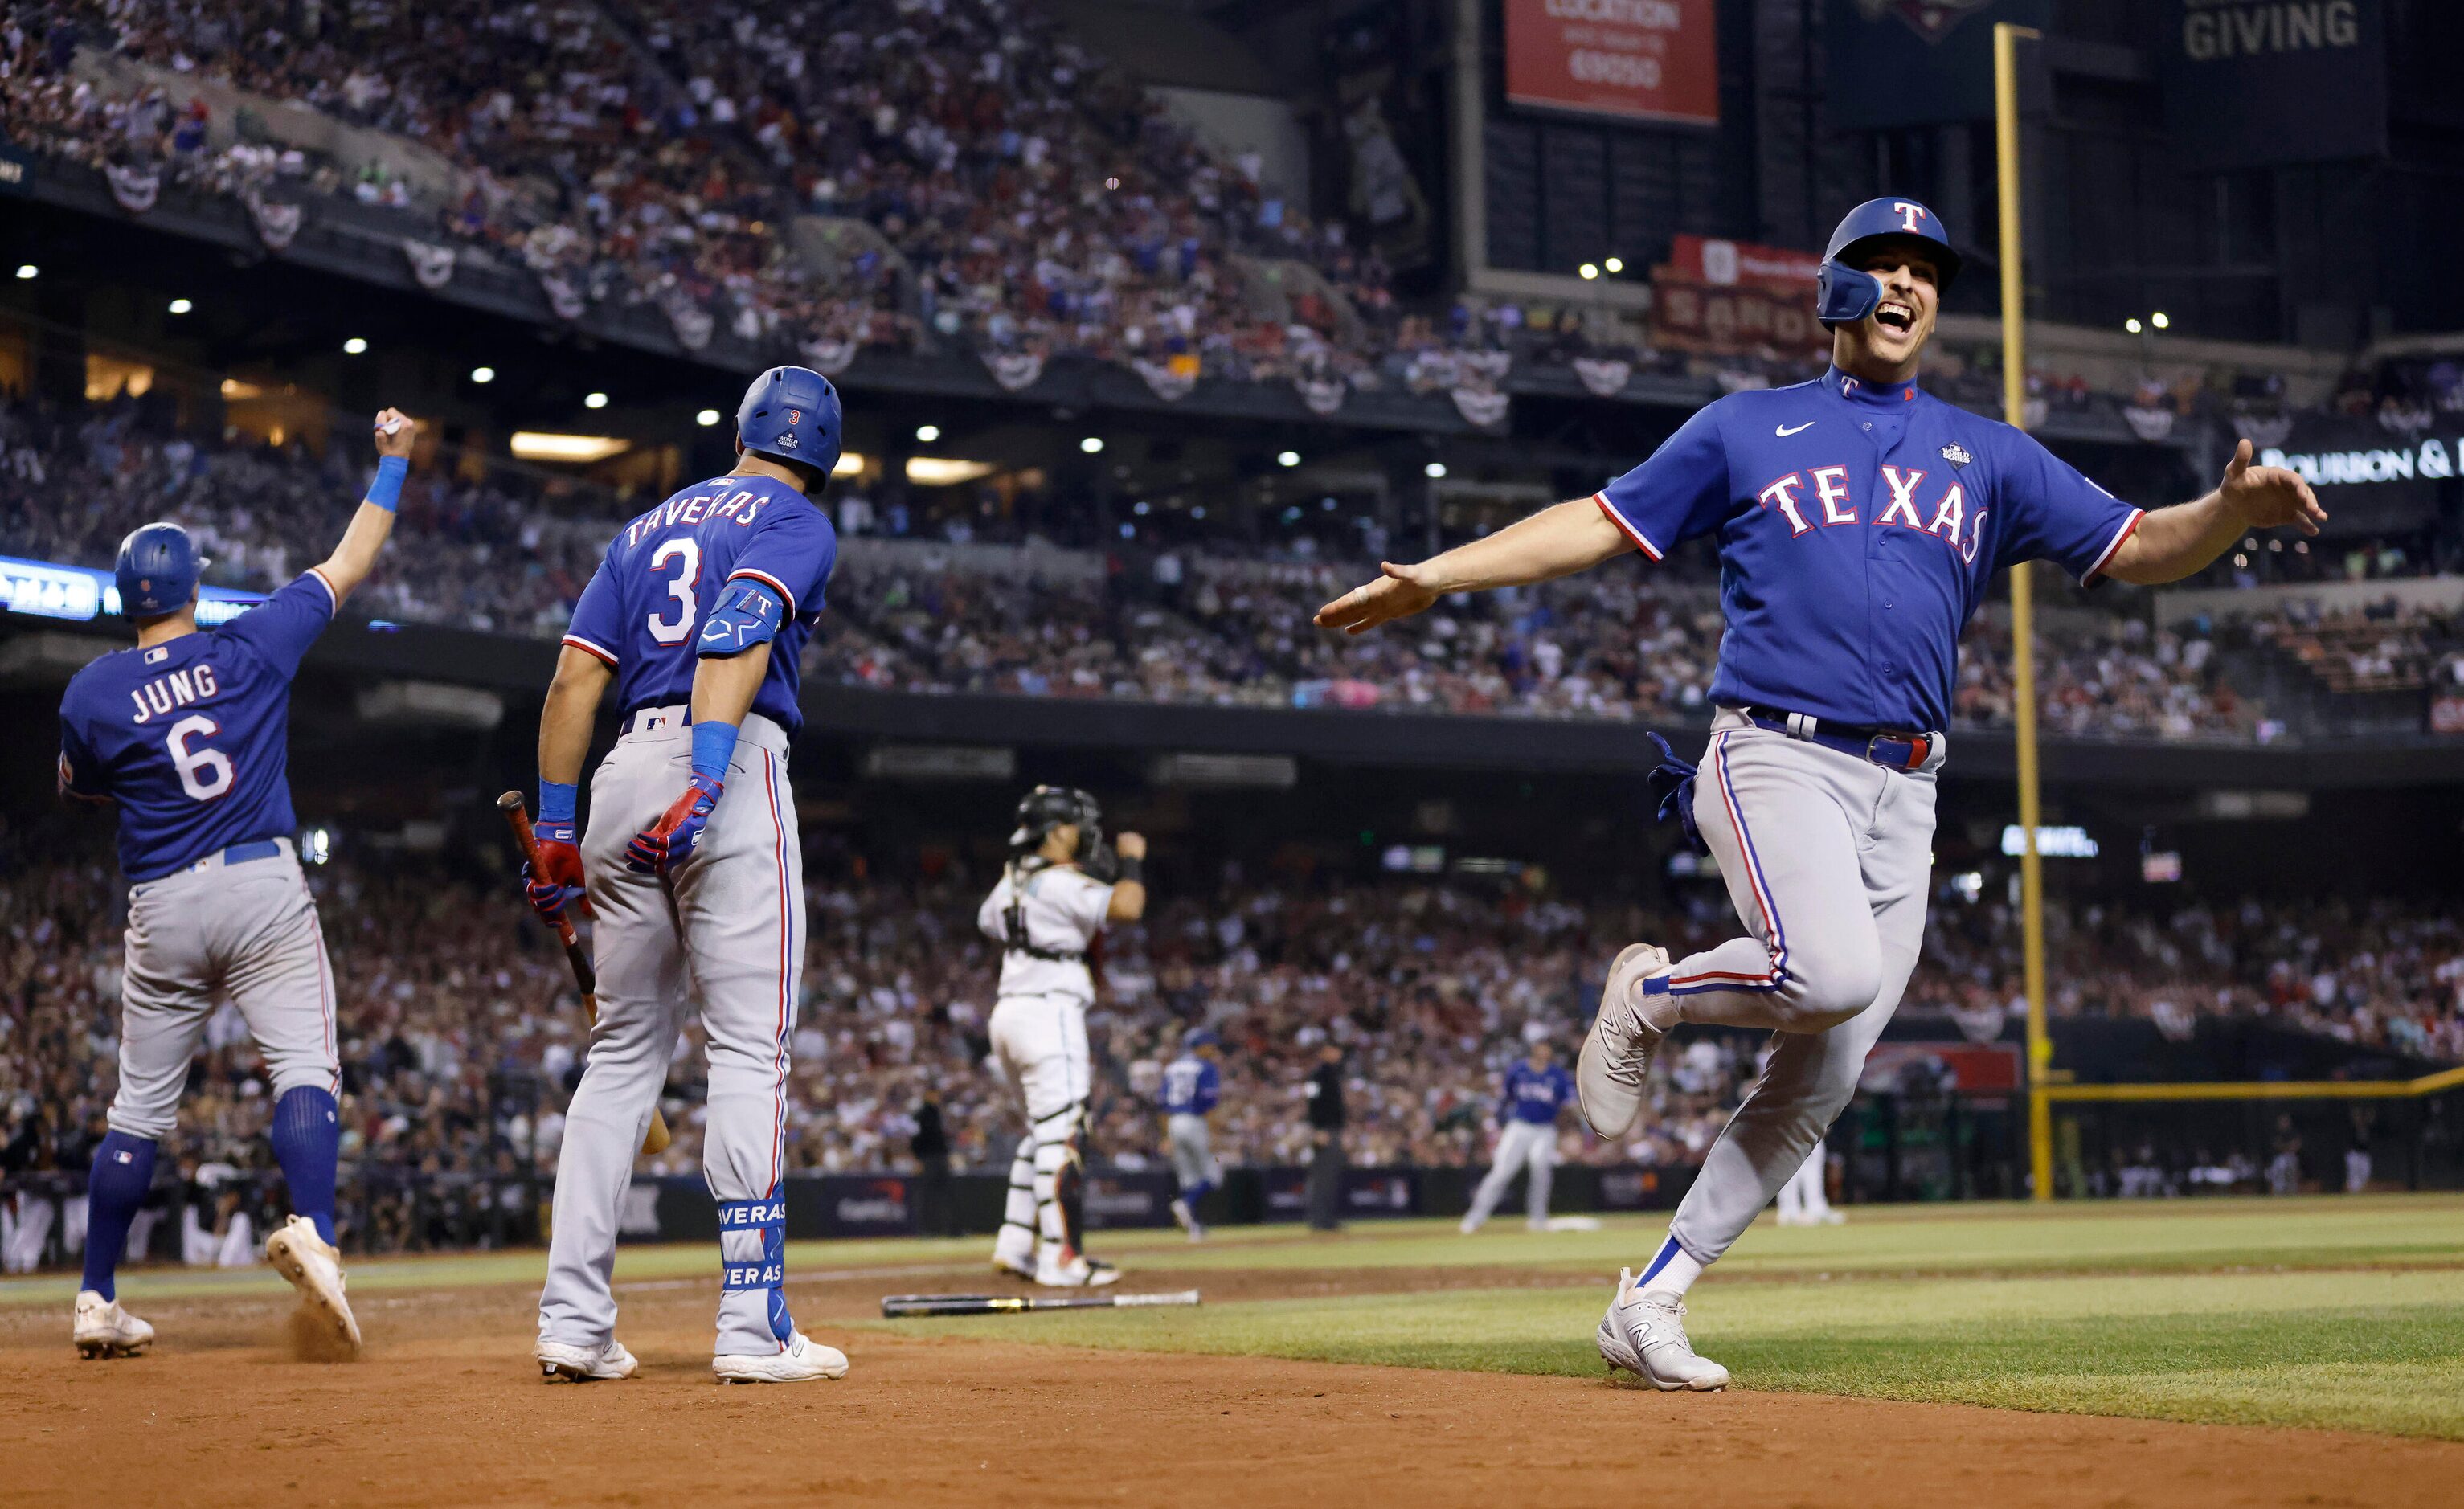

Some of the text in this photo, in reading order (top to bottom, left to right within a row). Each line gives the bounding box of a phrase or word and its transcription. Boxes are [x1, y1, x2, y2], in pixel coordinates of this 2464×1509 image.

[2184, 2, 2358, 60] GIVING
[1894, 202, 1926, 234] T
[1841, 375, 1860, 399] T
[788, 409, 800, 425] 3
[777, 440, 797, 449] SERIES
[779, 435, 798, 445] WORLD
[1942, 448, 1970, 459] WORLD
[1942, 454, 1971, 464] SERIES
[2417, 439, 2454, 479] &
[624, 491, 771, 551] TAVERAS
[1758, 464, 1989, 566] TEXAS
[646, 537, 703, 648] 3
[757, 595, 772, 617] T
[131, 665, 219, 724] JUNG
[166, 714, 238, 802] 6
